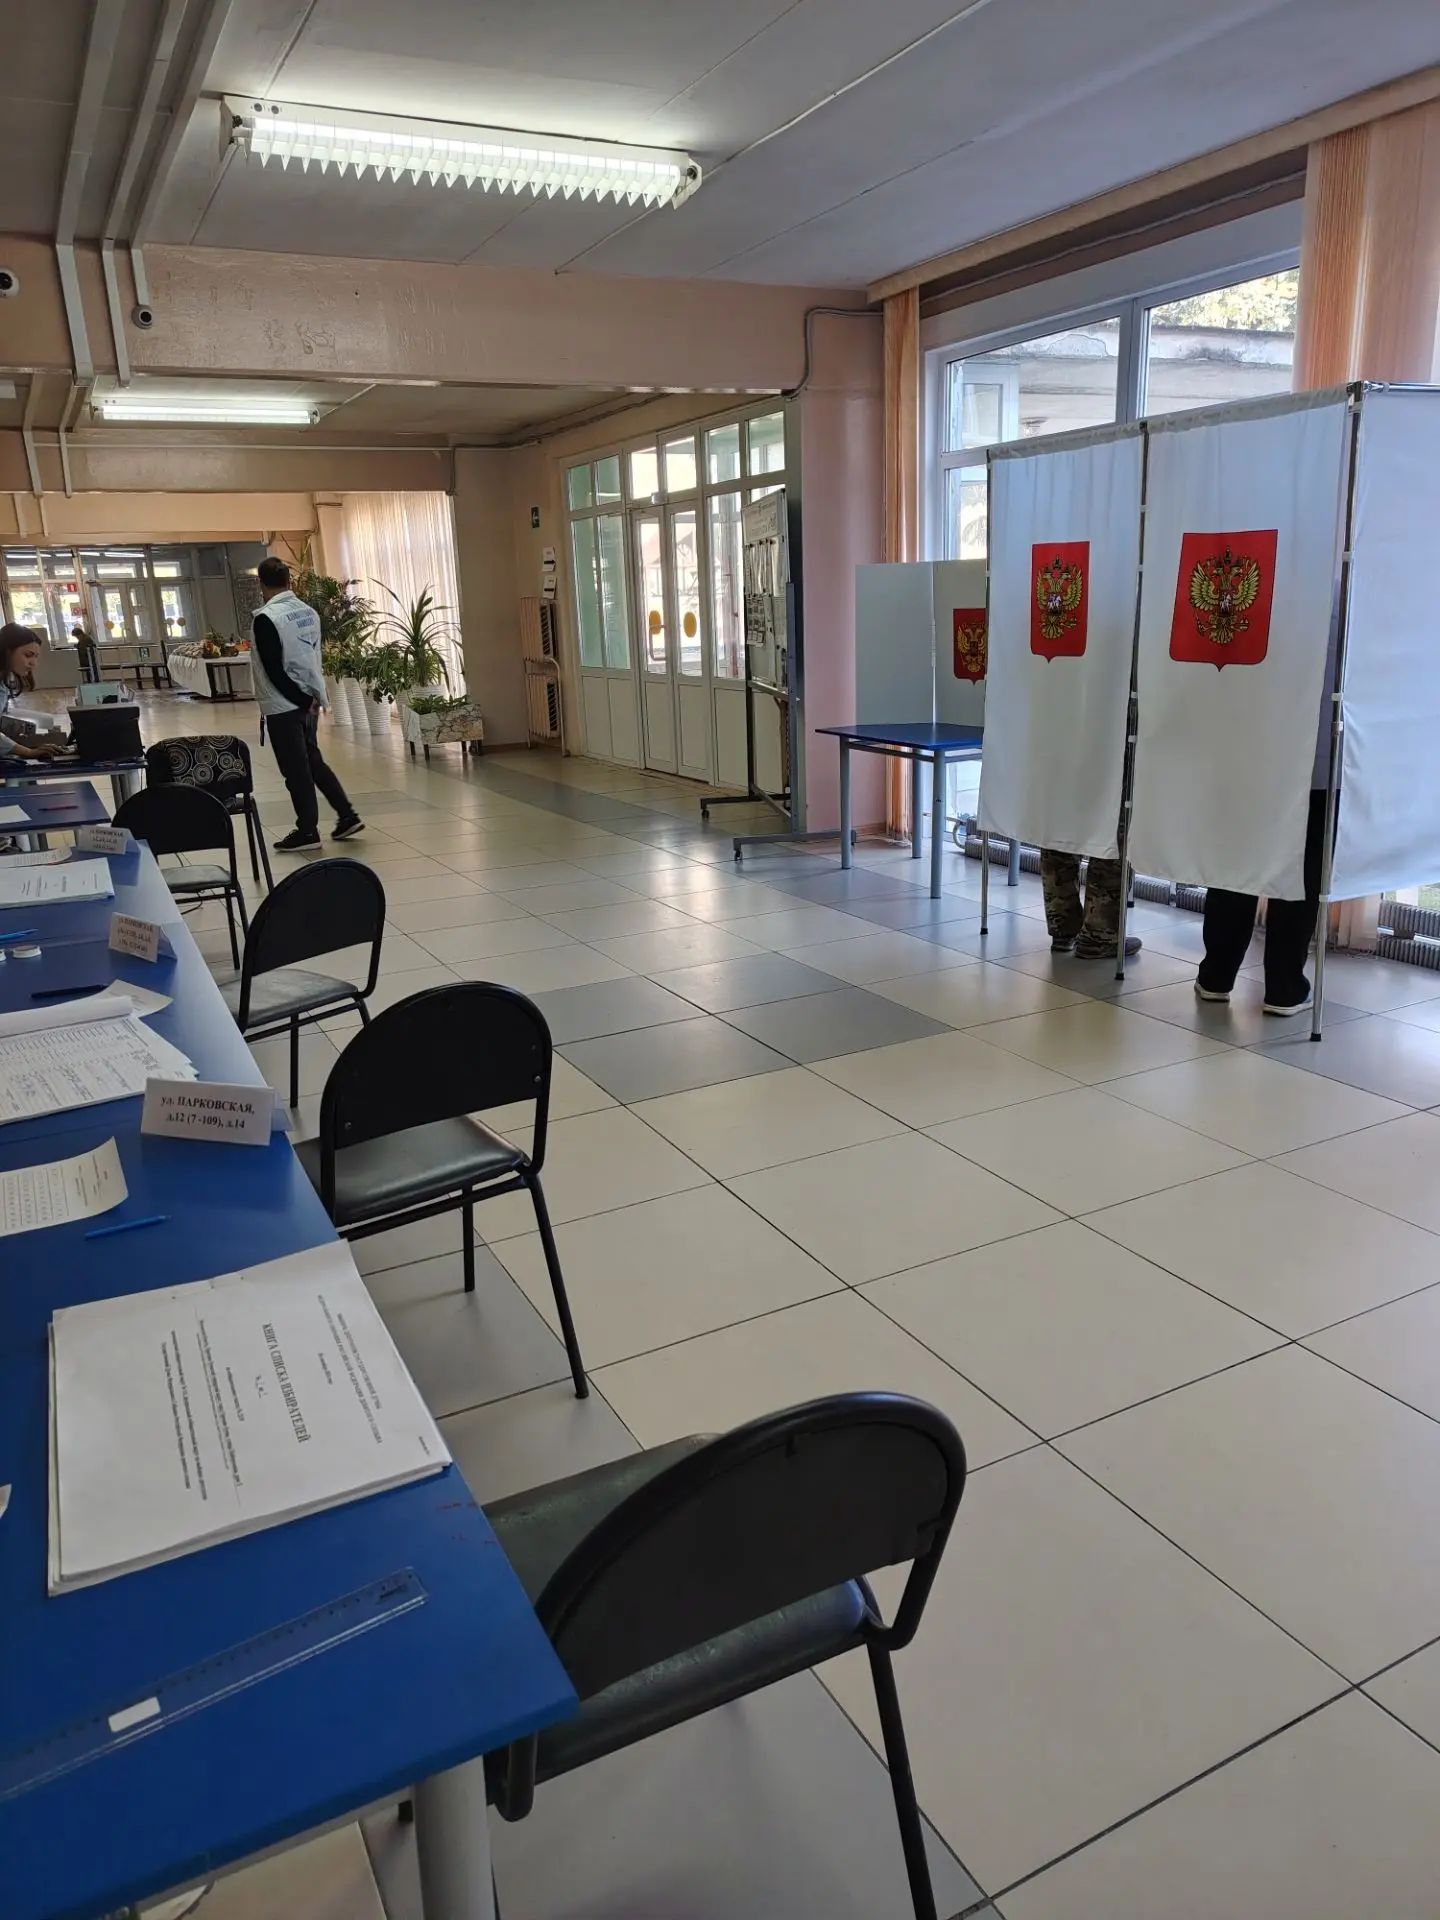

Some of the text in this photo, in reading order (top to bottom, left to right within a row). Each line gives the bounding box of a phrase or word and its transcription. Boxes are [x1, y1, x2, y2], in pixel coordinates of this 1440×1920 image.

[160, 1096, 255, 1115] ул. ПАРКОВСКАЯ,
[166, 1112, 185, 1122] д.12
[226, 1118, 245, 1129] д.14
[262, 1323, 311, 1443] КНИГА СПИСКА ИЗБИРАТЕЛЕЙ
